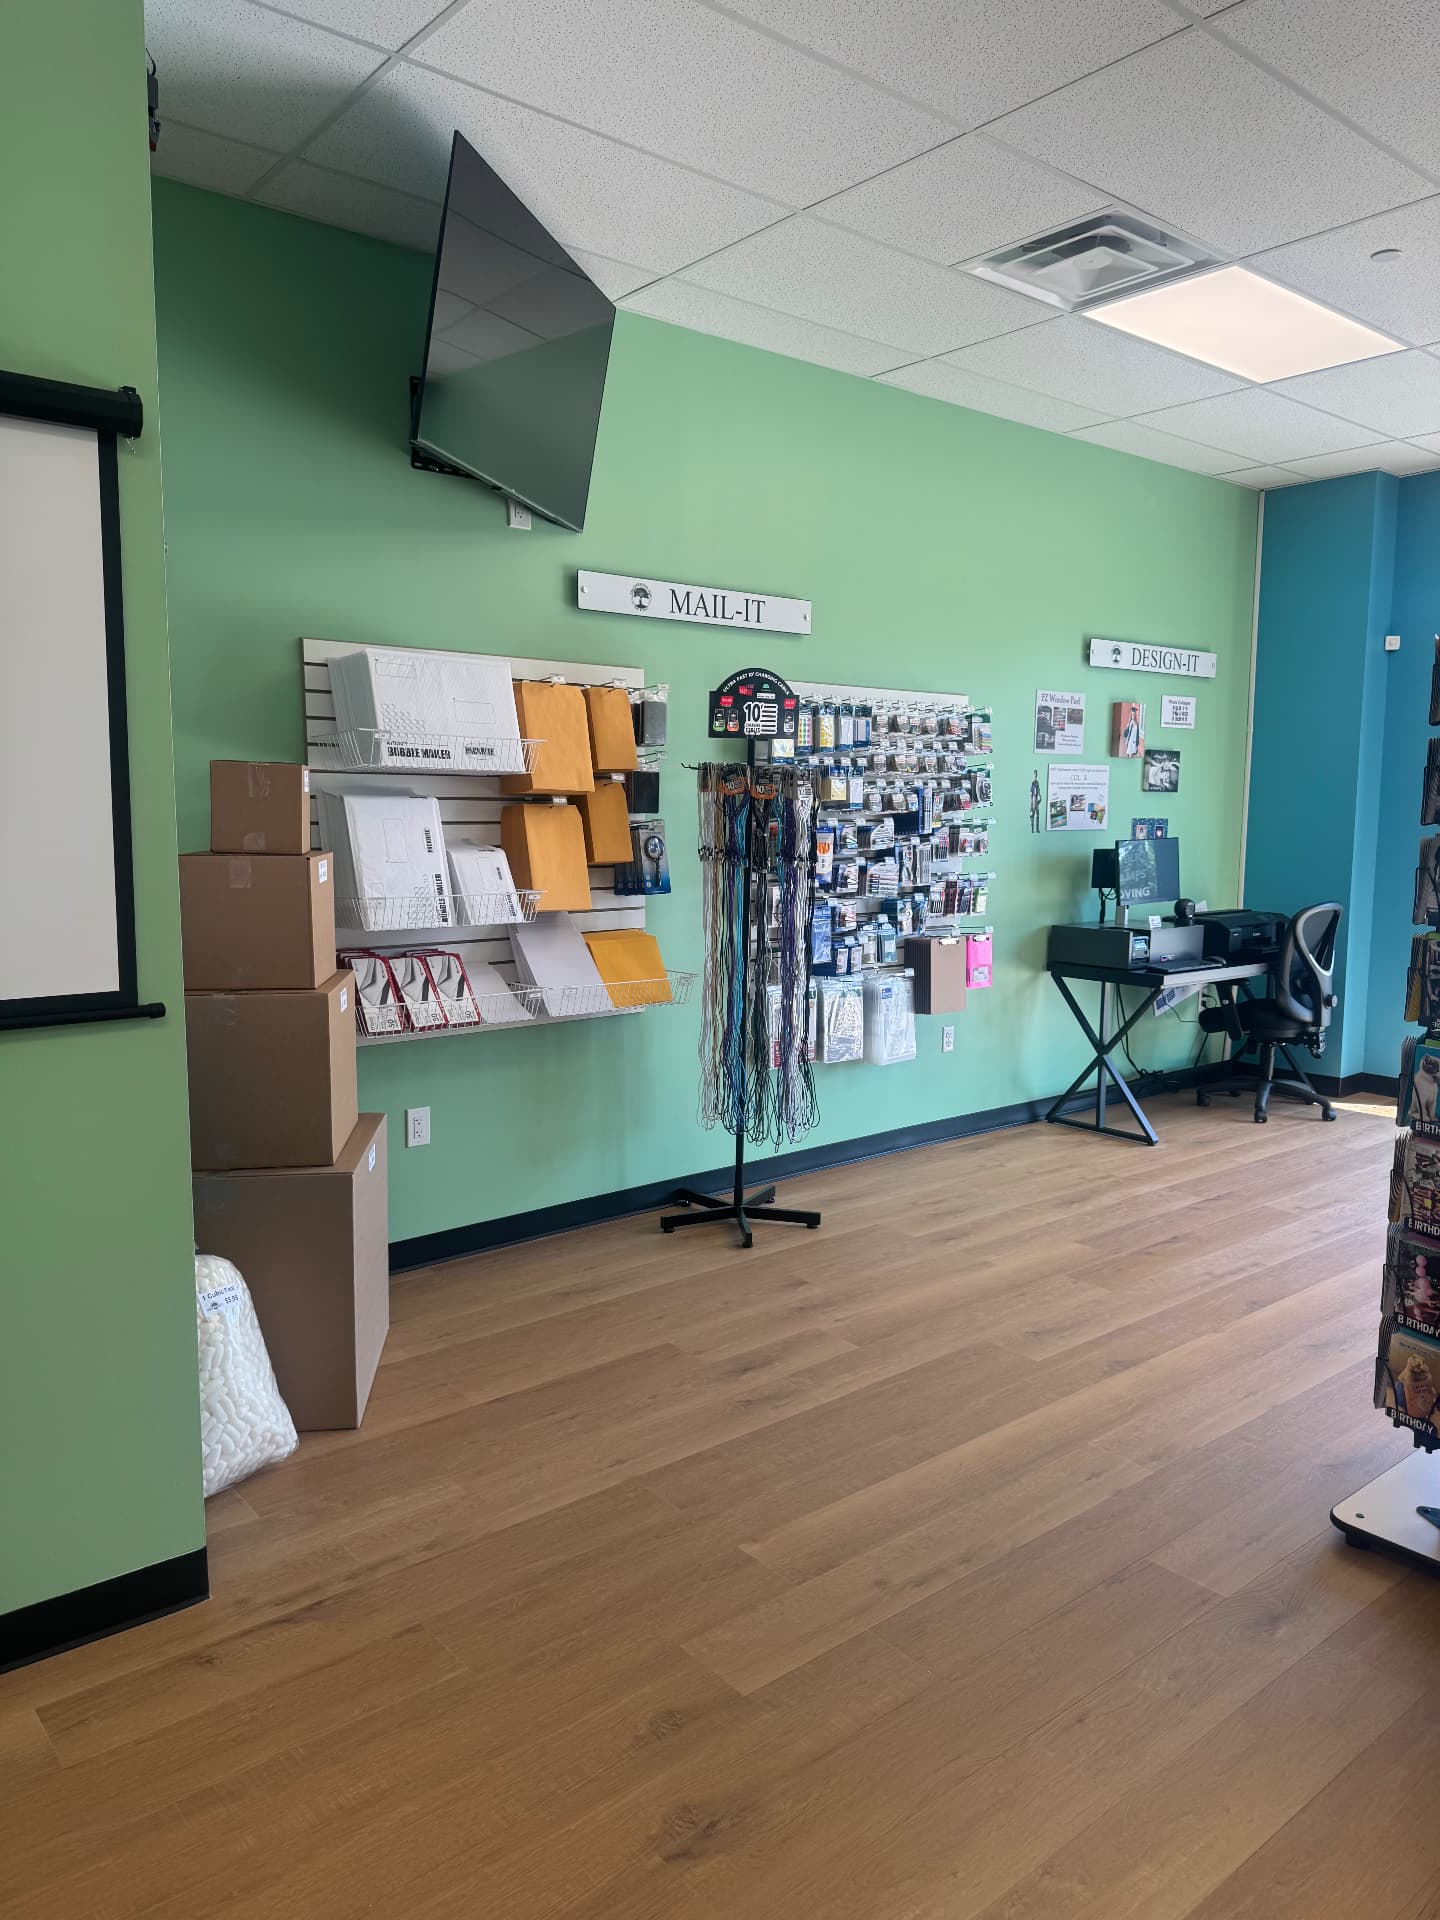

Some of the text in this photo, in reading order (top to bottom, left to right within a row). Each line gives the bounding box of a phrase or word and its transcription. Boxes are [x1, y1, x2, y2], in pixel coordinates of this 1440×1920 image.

[669, 588, 766, 624] MAIL-IT
[1131, 647, 1200, 673] DESIGN-IT
[387, 746, 420, 758] BUBBLE
[387, 1018, 395, 1028] 50
[1397, 1314, 1440, 1338] BRTHDAY
